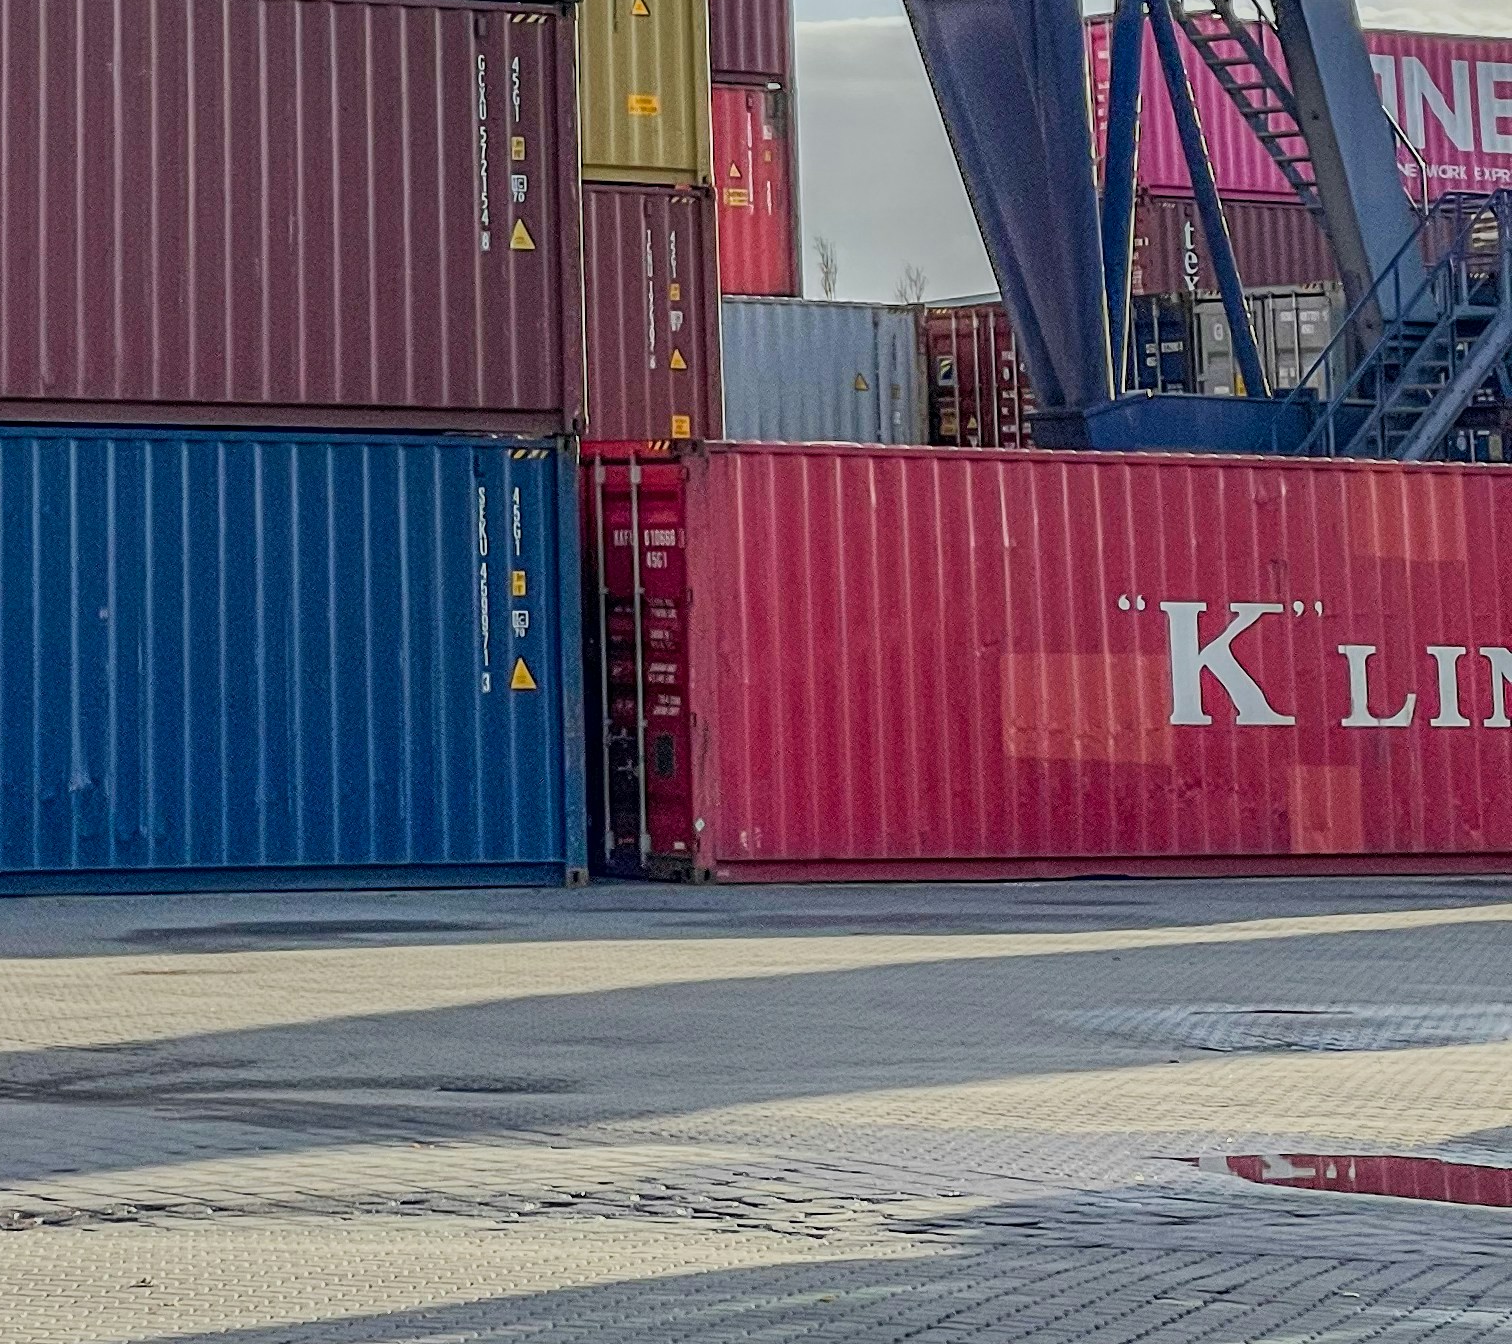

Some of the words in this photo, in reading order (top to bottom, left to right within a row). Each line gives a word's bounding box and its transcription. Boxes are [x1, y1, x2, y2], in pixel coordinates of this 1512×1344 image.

[477, 54, 487, 120] GCXU
[511, 56, 520, 122] 45G1
[479, 126, 489, 226] 572154
[1397, 162, 1468, 180] NEWORK
[512, 486, 522, 557] 45G1
